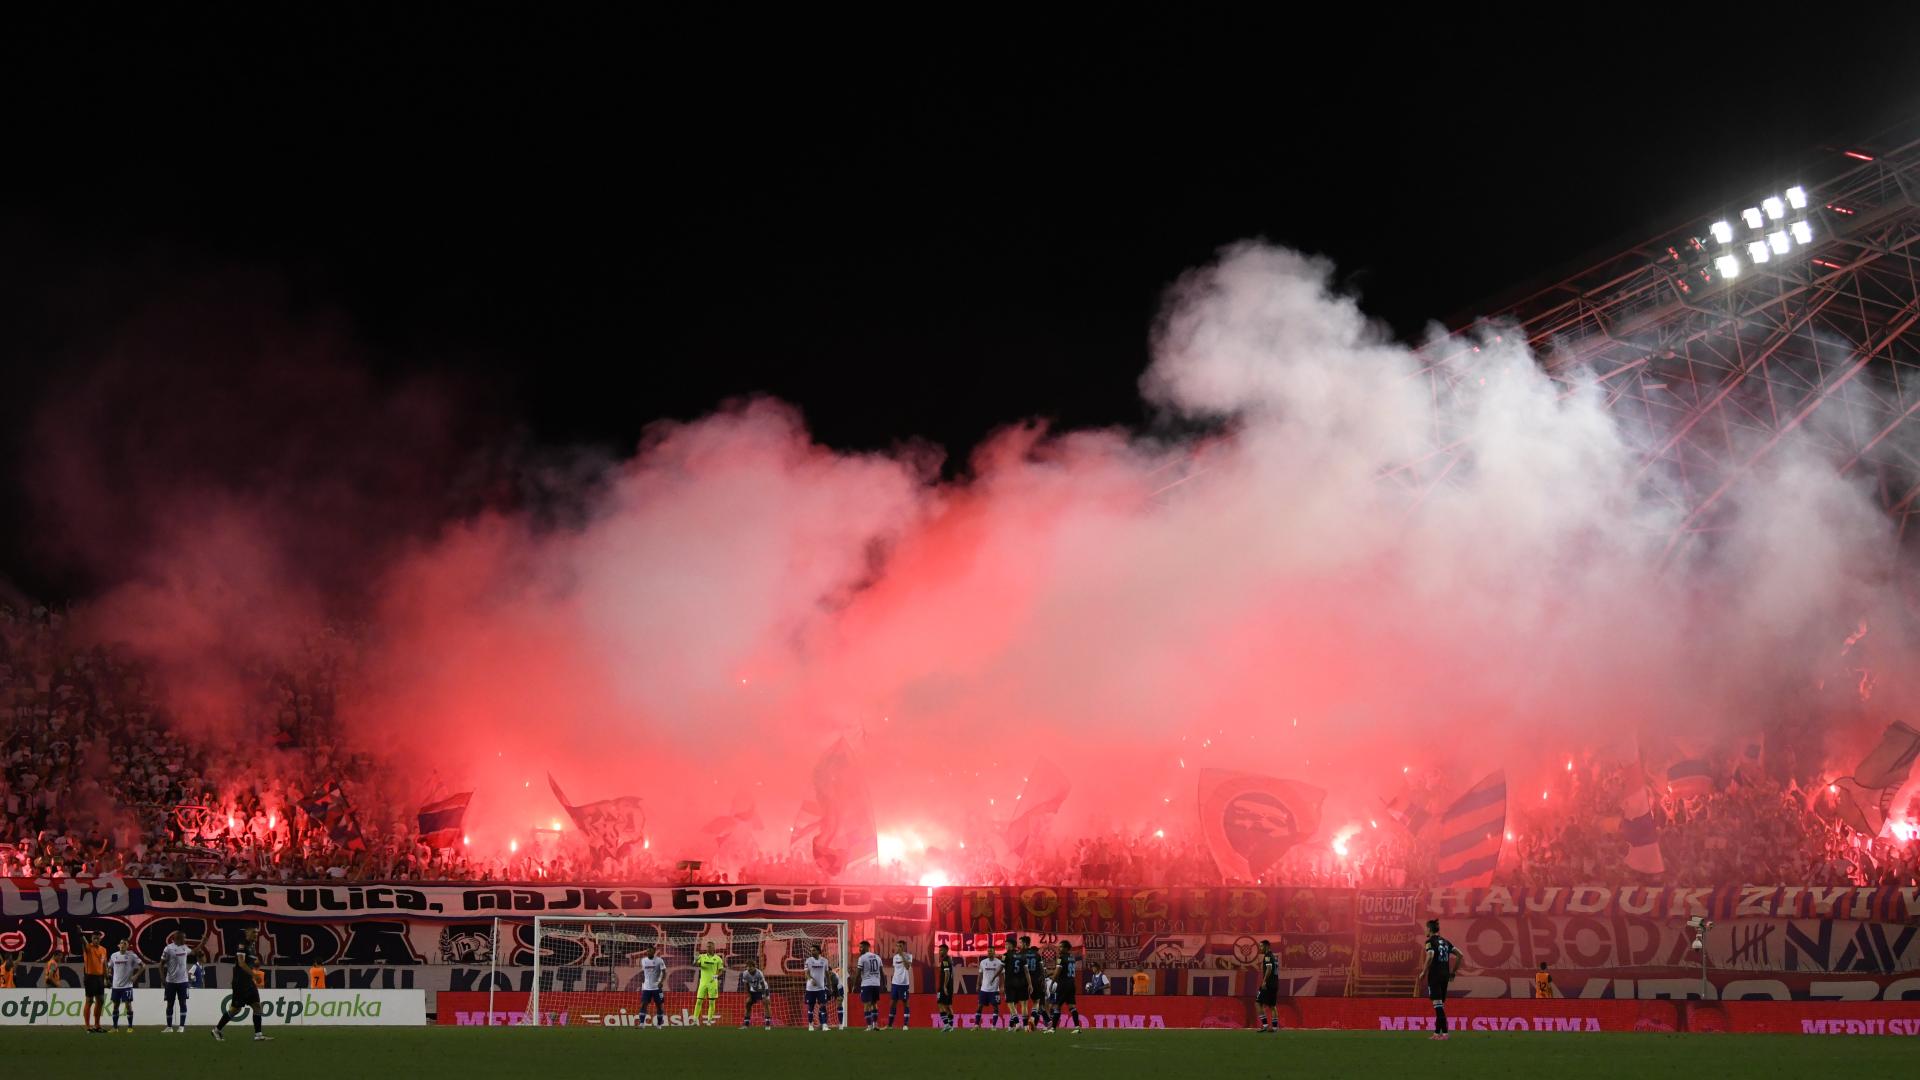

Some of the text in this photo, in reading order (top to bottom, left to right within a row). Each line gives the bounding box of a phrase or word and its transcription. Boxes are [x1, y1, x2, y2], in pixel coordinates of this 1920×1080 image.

[1358, 894, 1416, 916] TORCIDA
[1427, 885, 1714, 918] HAJDUK
[313, 976, 320, 987] 7
[2, 994, 130, 1024] otpbaka
[261, 994, 382, 1024] otpbanka
